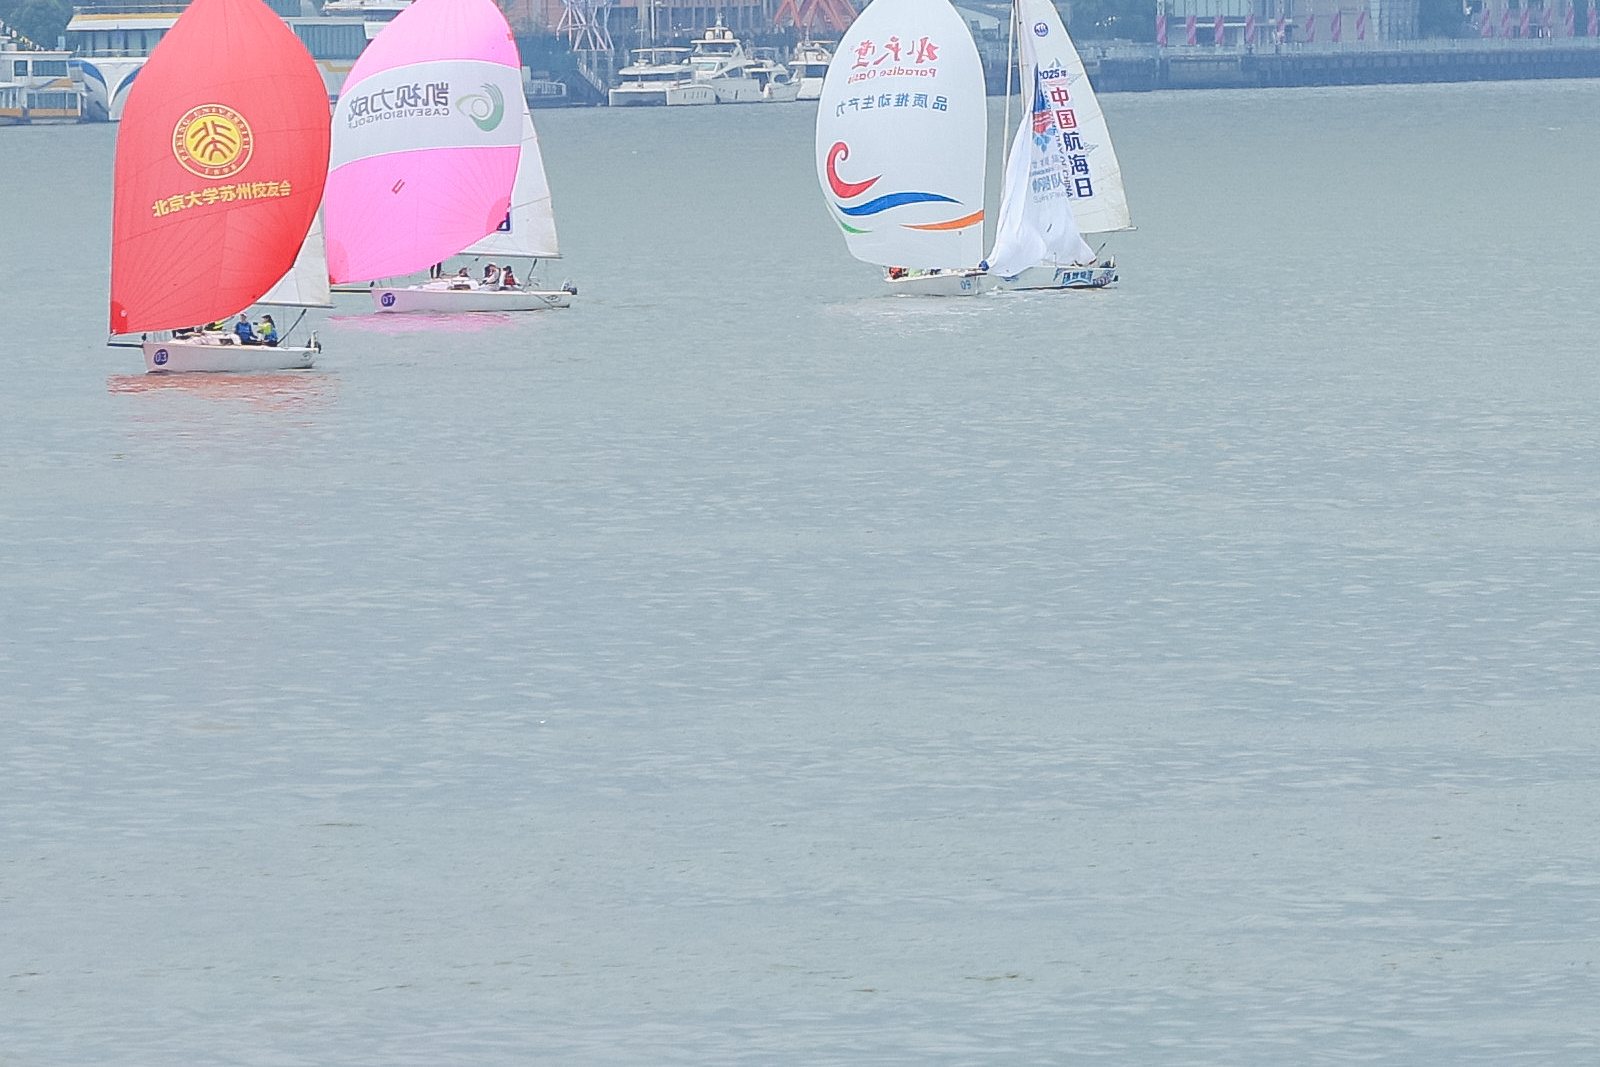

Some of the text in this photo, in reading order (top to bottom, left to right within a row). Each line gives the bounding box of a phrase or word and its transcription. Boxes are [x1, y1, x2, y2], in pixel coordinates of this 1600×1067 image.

[1050, 86, 1093, 198] 中国航海日
[151, 180, 292, 218] 北京大学苏州校友会
